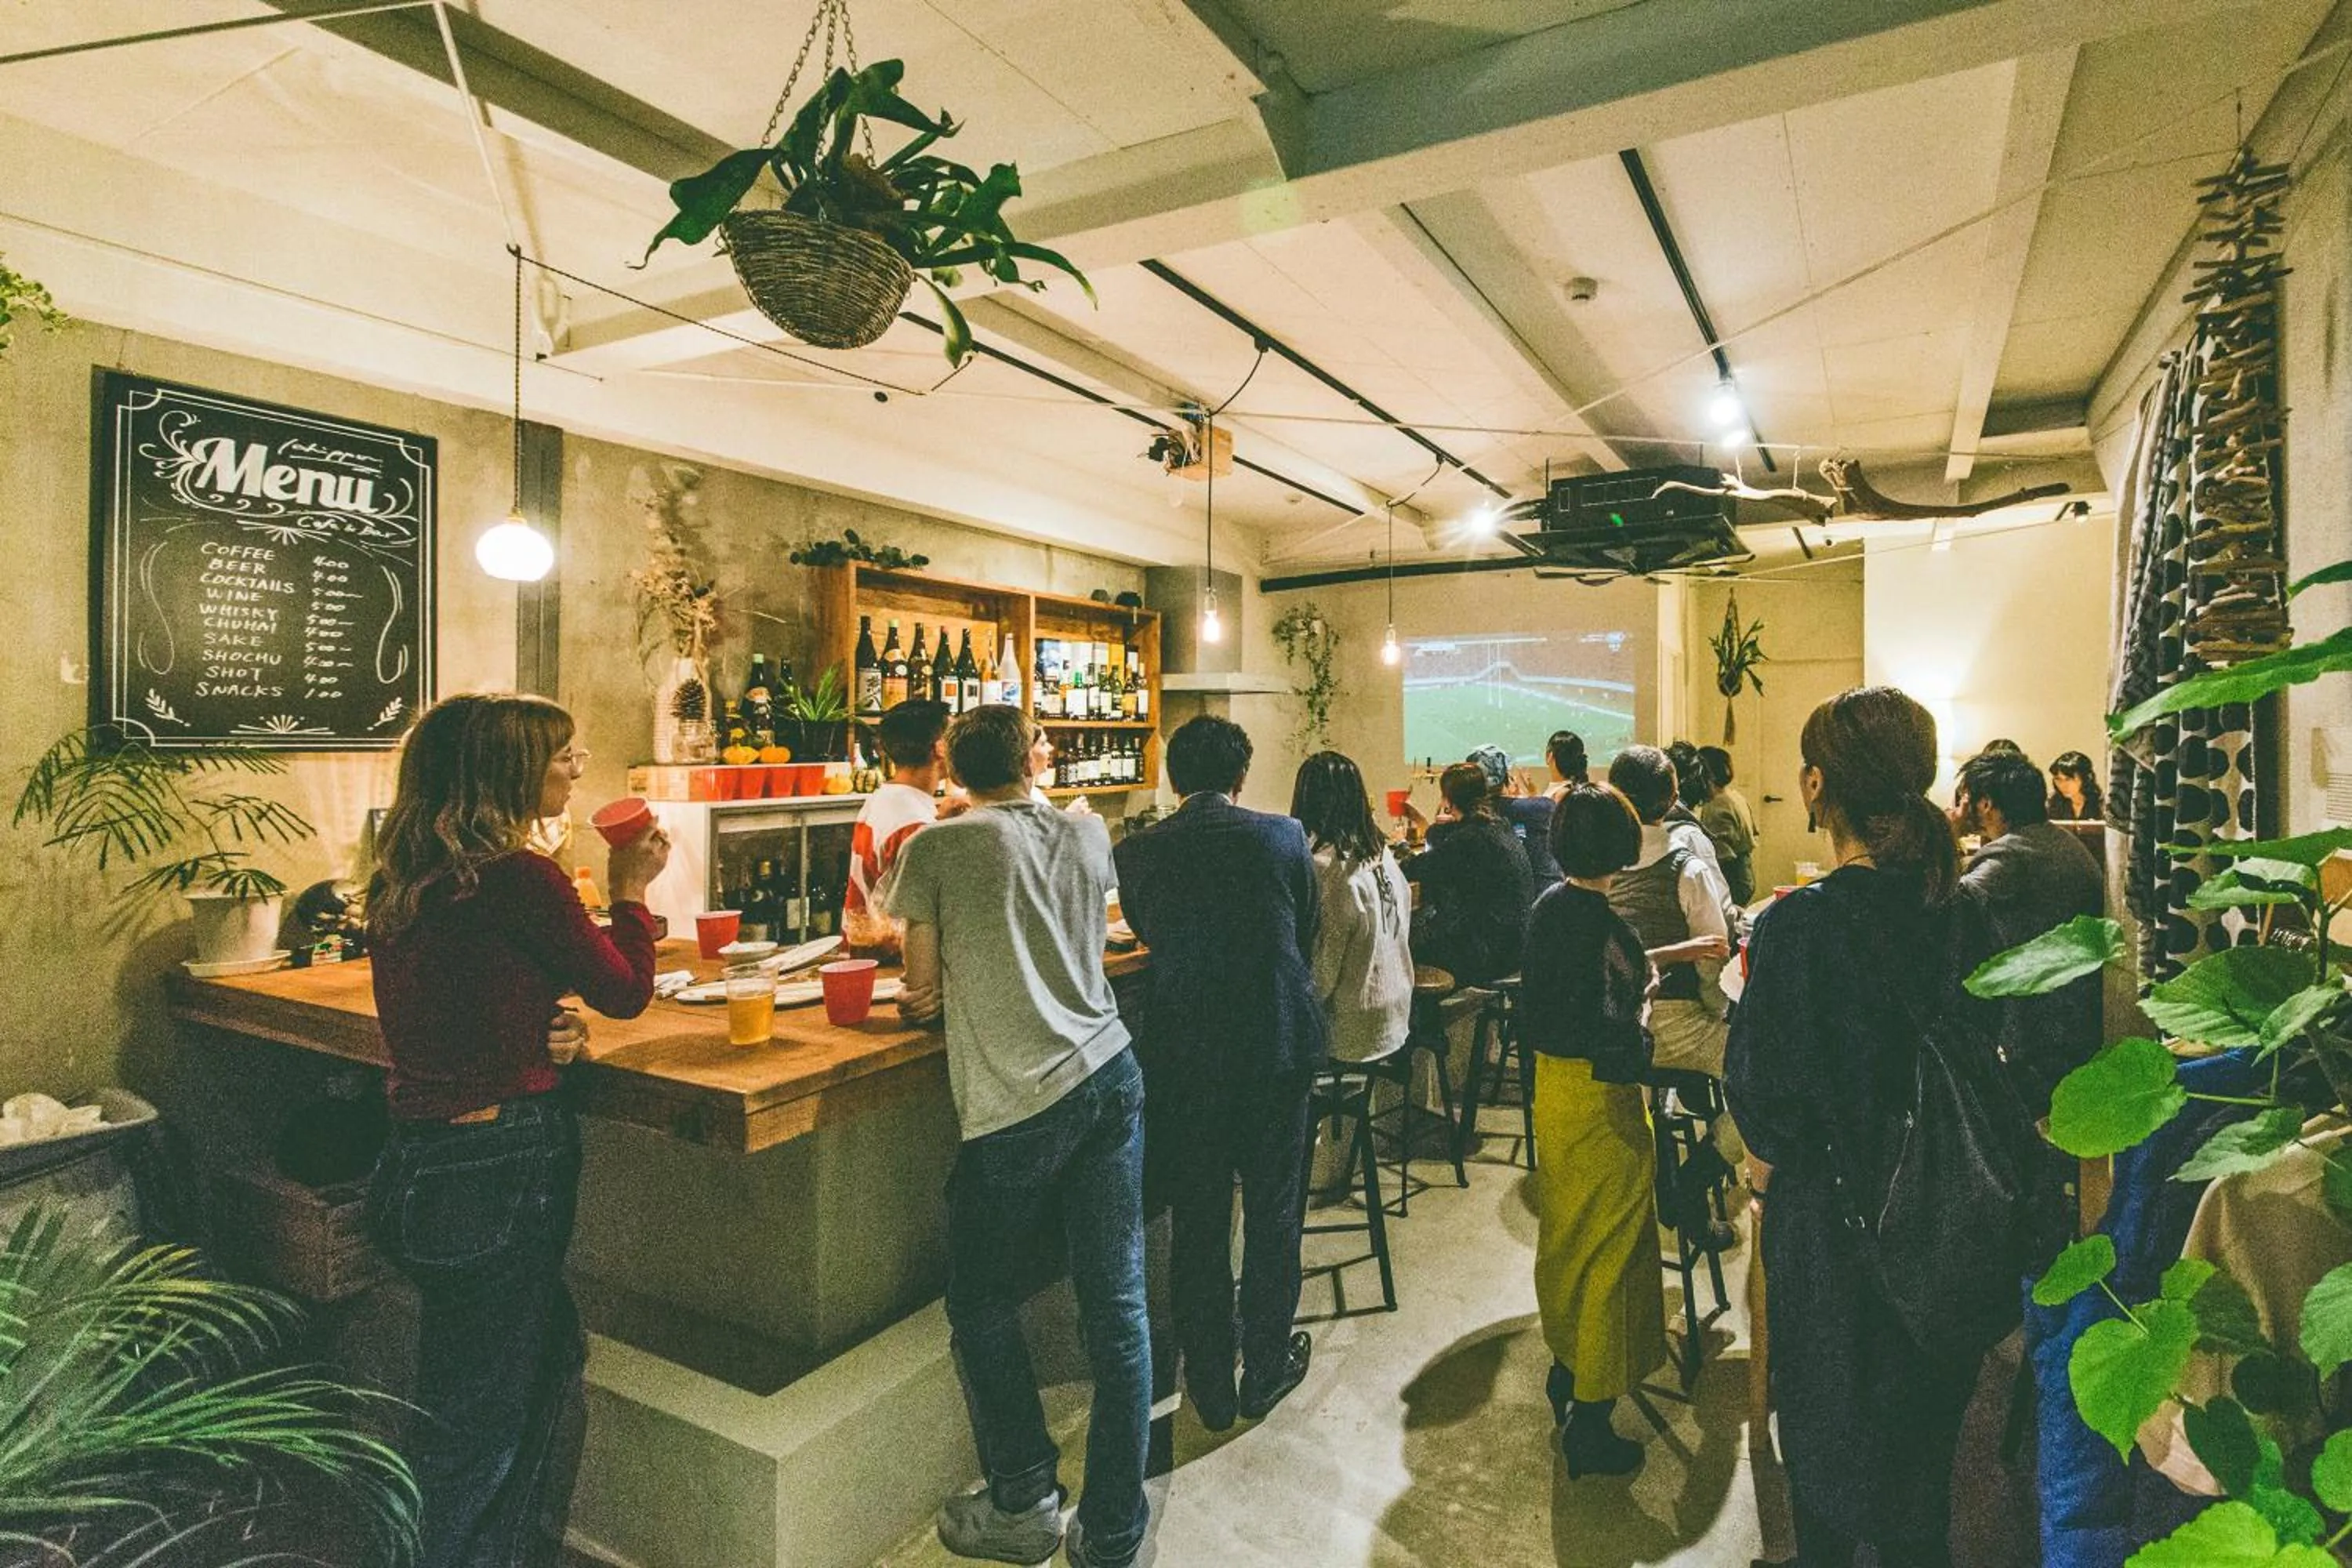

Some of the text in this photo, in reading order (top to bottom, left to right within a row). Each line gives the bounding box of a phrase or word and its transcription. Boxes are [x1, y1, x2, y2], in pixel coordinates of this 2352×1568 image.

[191, 437, 378, 514] Menu
[200, 542, 350, 568] COFFEE 400
[209, 557, 266, 575] BEER
[200, 572, 295, 593] COCKTAILS
[206, 588, 263, 601] WINE
[199, 603, 278, 621] WHISKY
[203, 617, 277, 633] CHUHAI
[203, 632, 263, 646] SAKE
[201, 648, 283, 666] SHOCHU
[205, 666, 262, 681] SHOT
[195, 681, 285, 697] SNACKS
